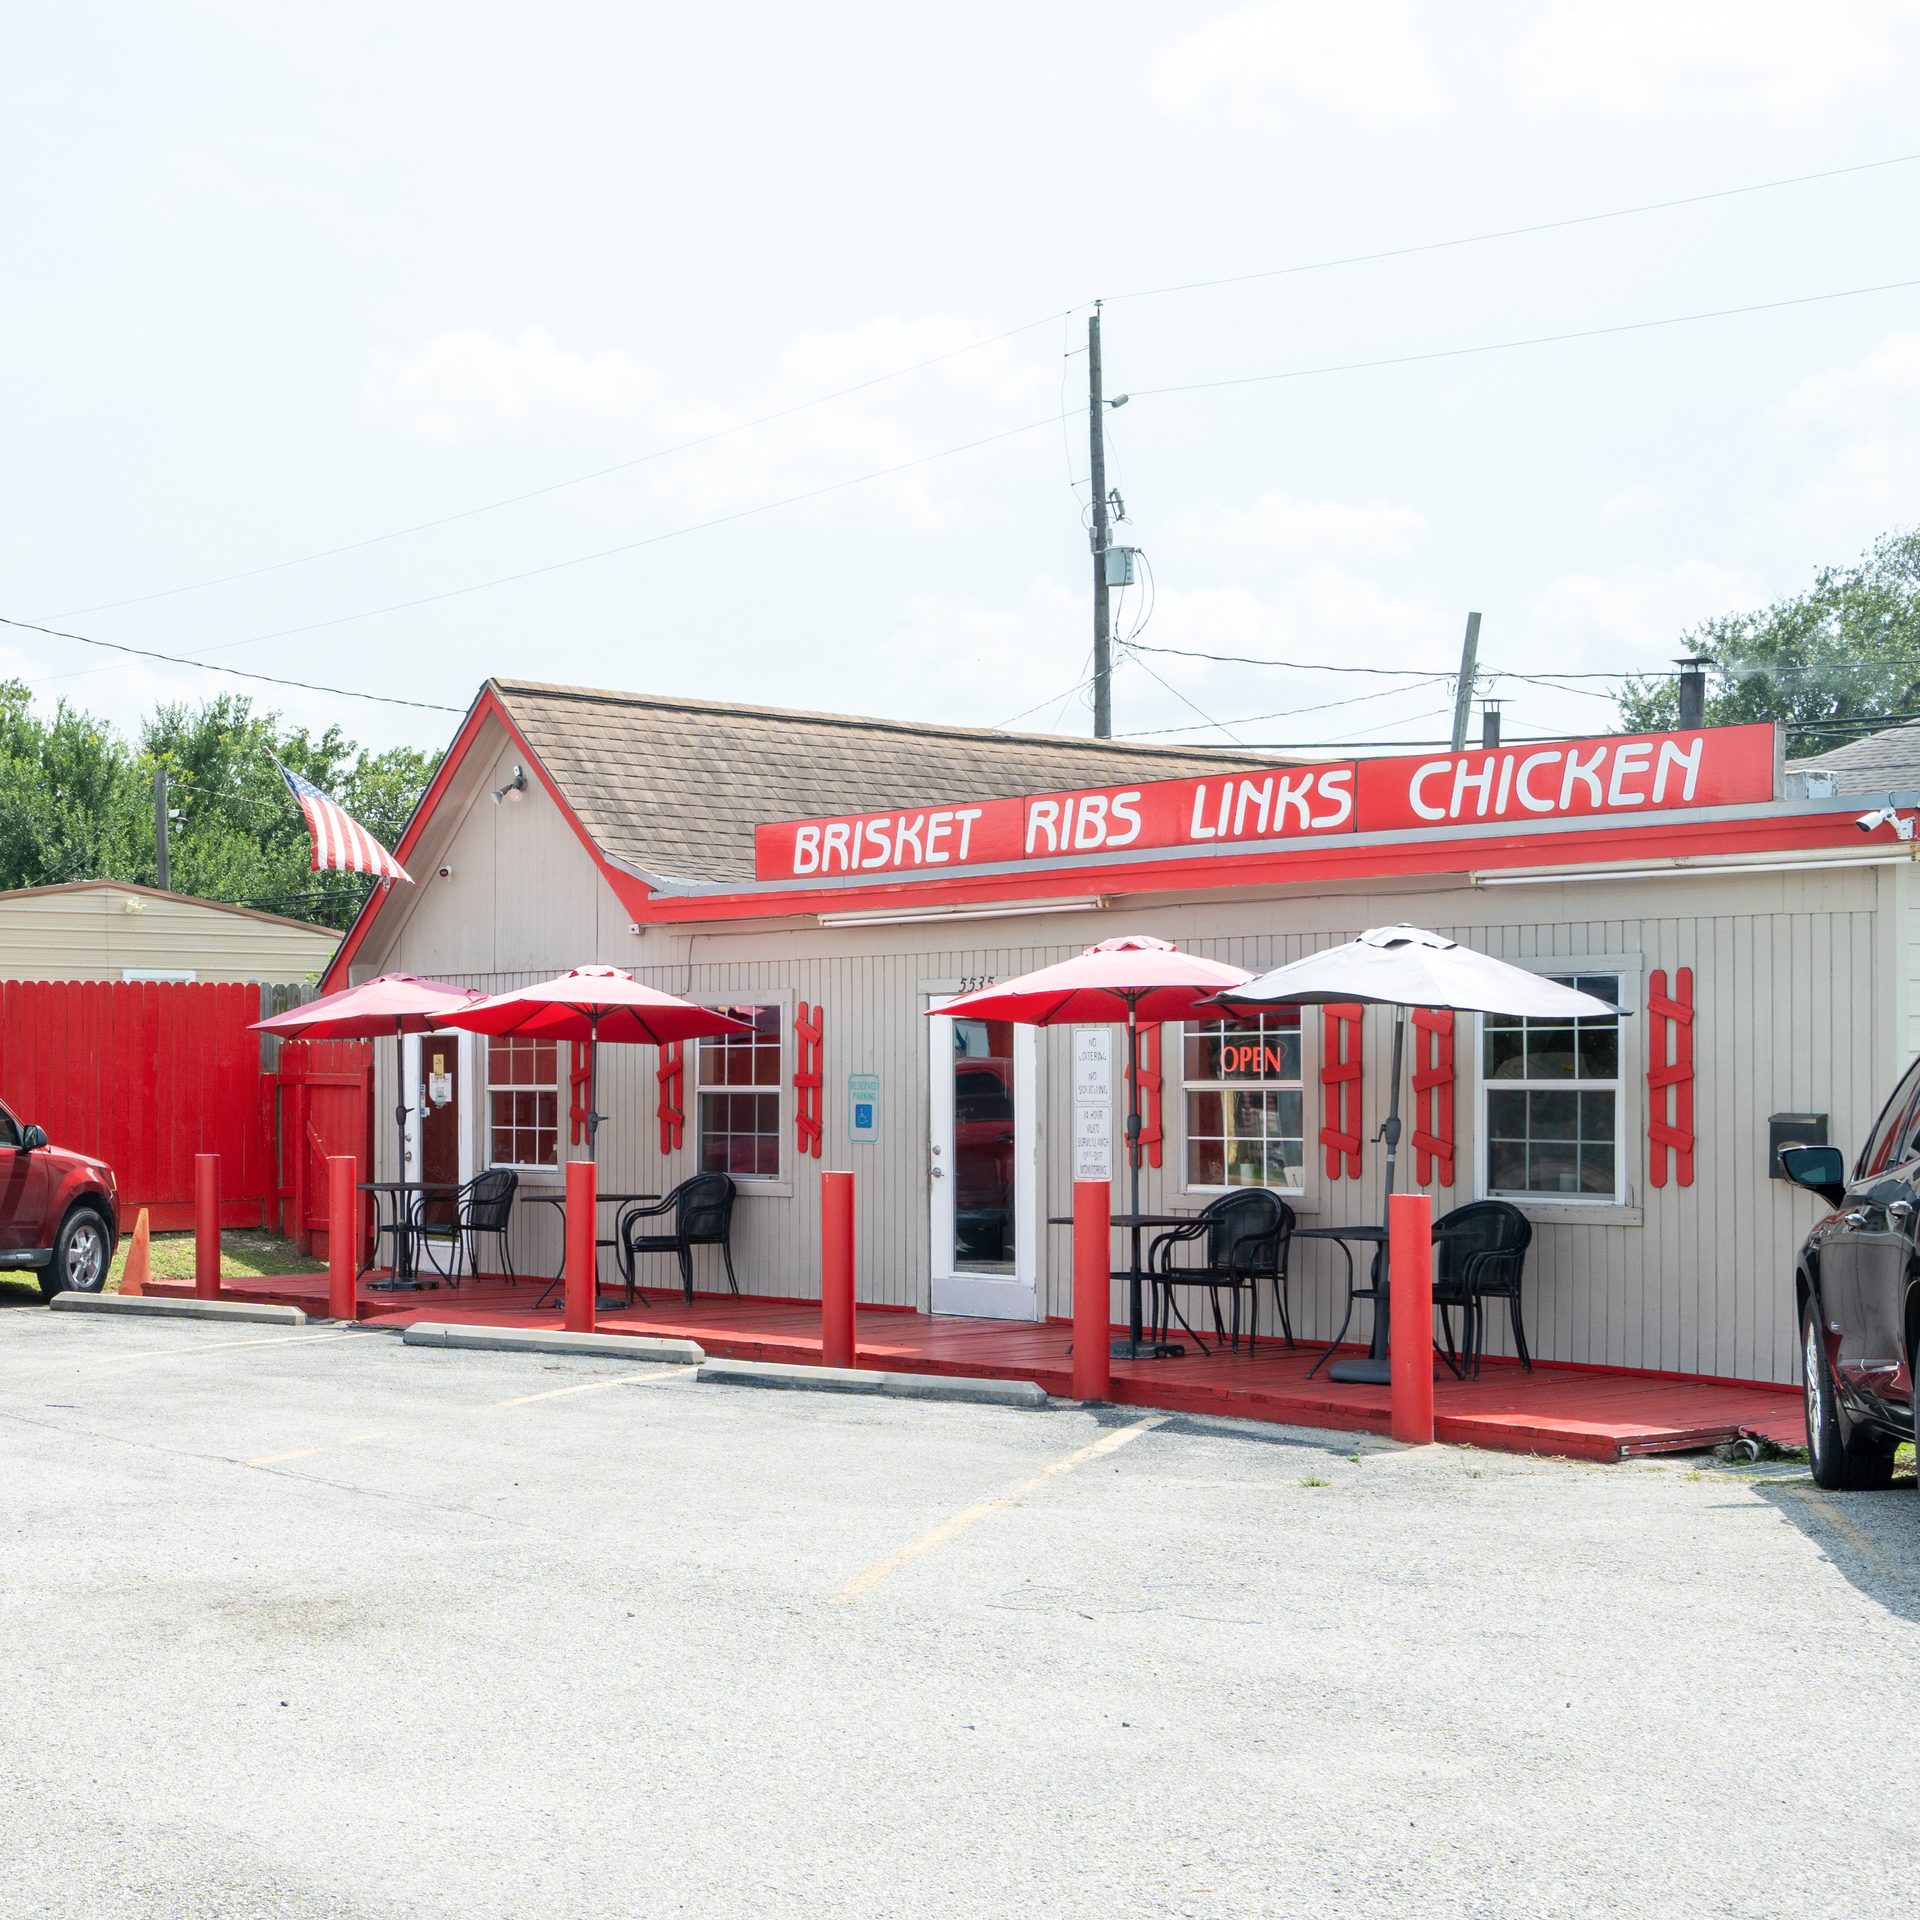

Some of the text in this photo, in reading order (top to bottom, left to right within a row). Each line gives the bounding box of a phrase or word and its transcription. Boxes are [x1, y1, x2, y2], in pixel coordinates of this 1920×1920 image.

[793, 737, 1704, 875] BRISKET RIBS LINKS CHICKEN
[1088, 1037, 1097, 1047] NO
[1079, 1051, 1107, 1061] LOITERING
[1220, 1046, 1280, 1072] OPEN
[1088, 1071, 1097, 1081] NO
